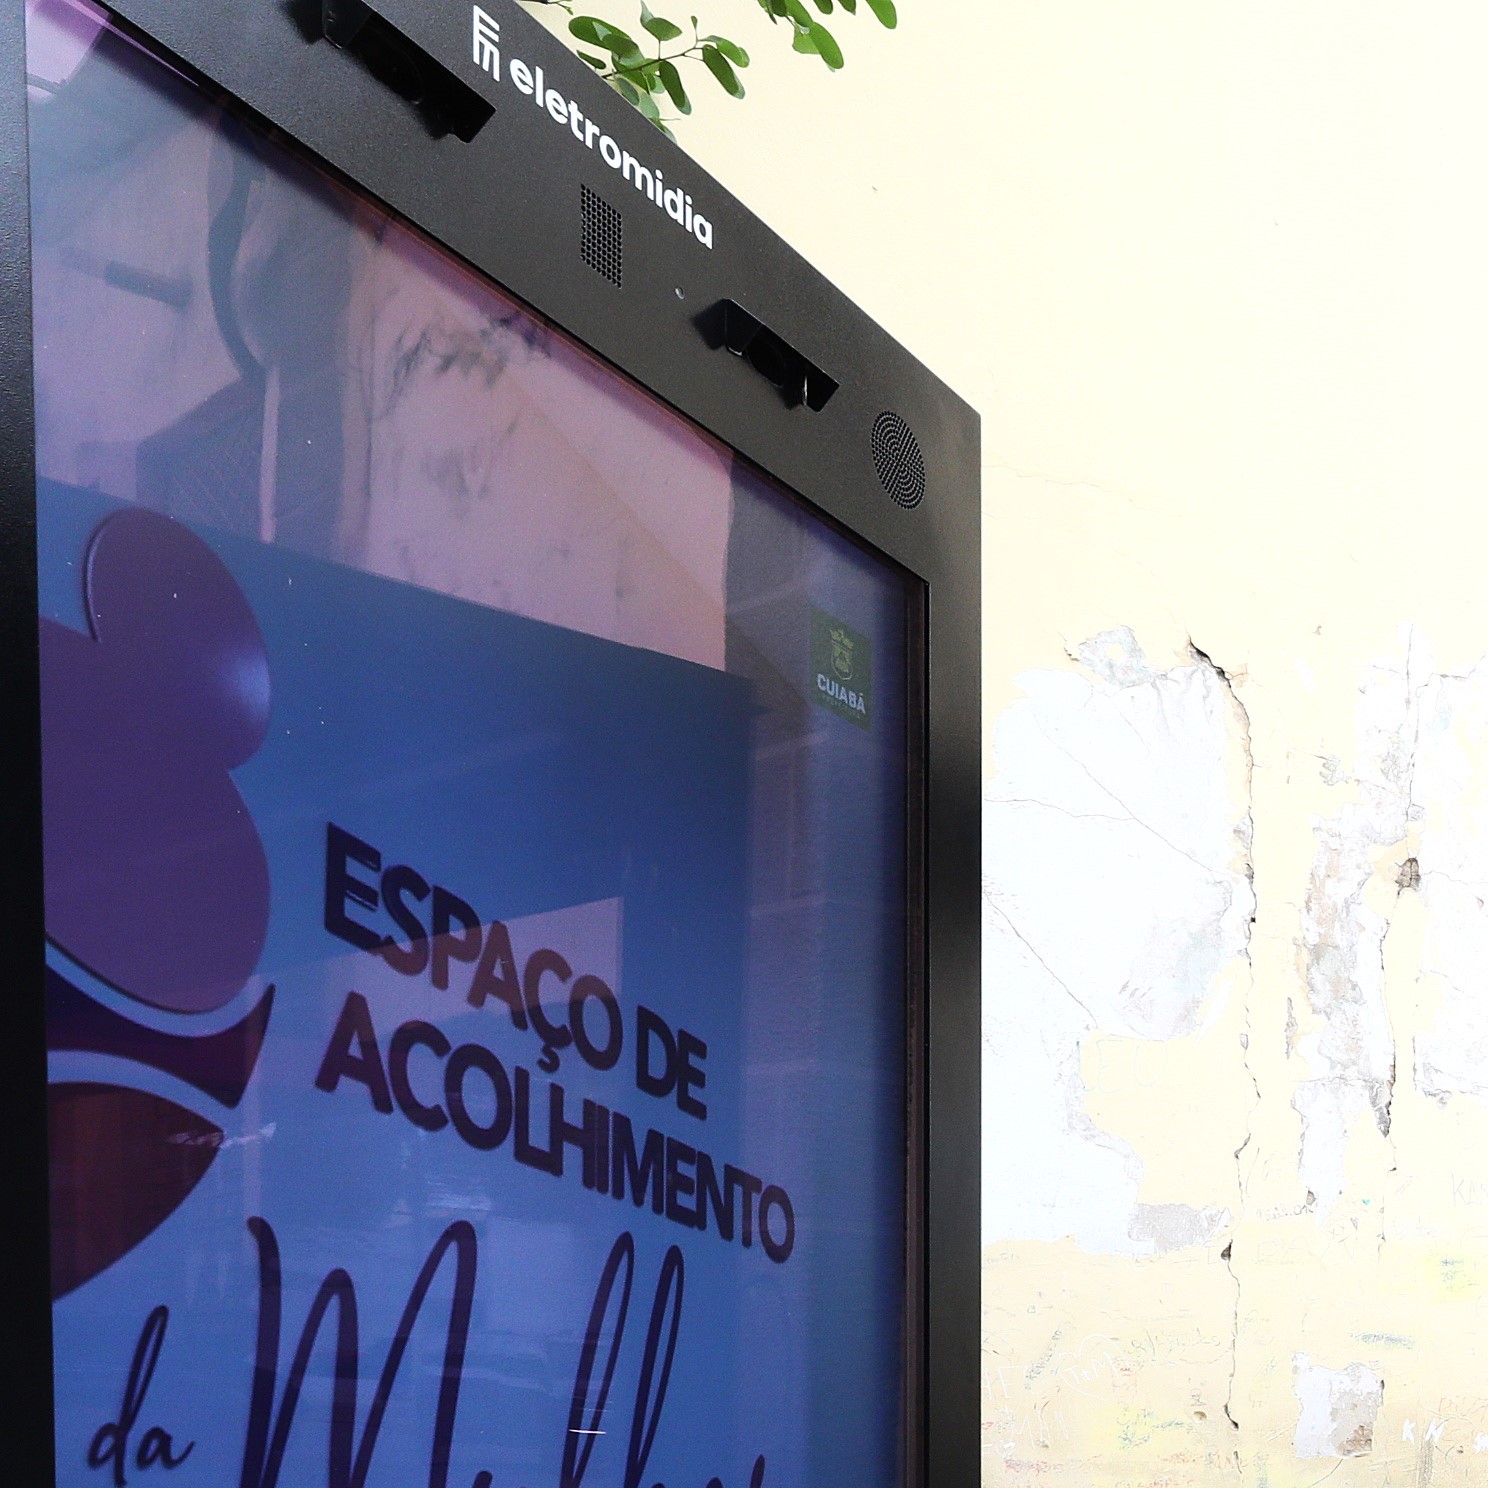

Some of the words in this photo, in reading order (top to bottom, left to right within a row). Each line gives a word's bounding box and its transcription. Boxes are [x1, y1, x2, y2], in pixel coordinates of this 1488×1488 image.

[509, 58, 714, 250] eletromidia
[817, 673, 866, 714] CUIABÁ
[325, 822, 623, 1073] ESPAÇO
[635, 1005, 708, 1122] DE
[314, 990, 795, 1264] ACOLHIMENTO
[87, 1304, 195, 1488] da
